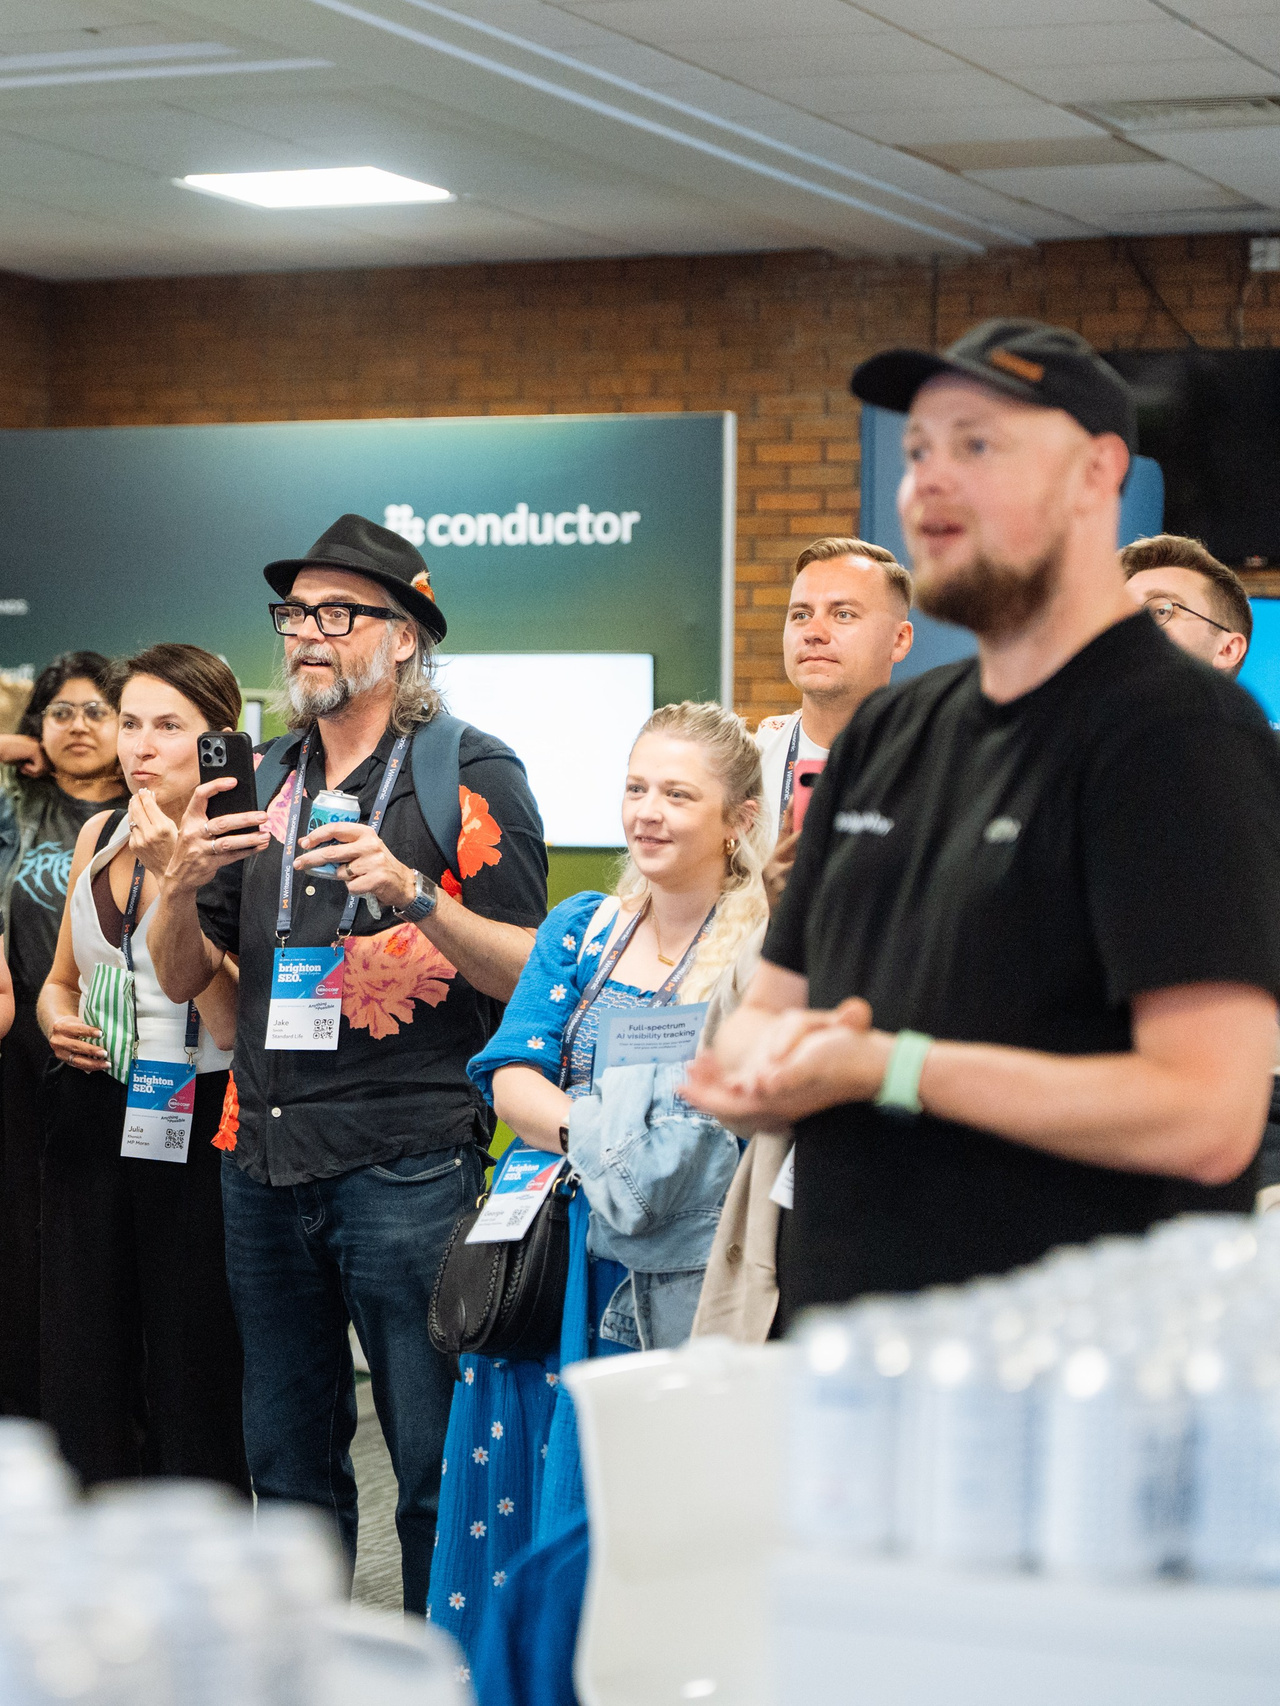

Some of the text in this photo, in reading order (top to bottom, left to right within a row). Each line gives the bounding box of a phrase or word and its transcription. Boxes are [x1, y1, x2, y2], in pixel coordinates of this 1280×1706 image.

[426, 502, 641, 548] conductor
[295, 763, 305, 794] Writesonic
[380, 768, 396, 800] Writesonic
[784, 770, 793, 801] Writesonic
[288, 814, 298, 846] Writesonic
[282, 865, 292, 899] Writesonic
[128, 886, 138, 915] Writesonic
[278, 963, 322, 974] brighton
[278, 974, 302, 982] SEO.
[590, 960, 614, 991] Writesonic
[672, 952, 696, 983] Writesonic
[565, 1009, 584, 1044] Writesonic
[627, 1032, 662, 1040] visibility
[663, 1030, 696, 1038] tracking
[628, 1022, 686, 1032] Full-spectrum
[132, 1084, 156, 1094] SEO.
[133, 1074, 174, 1086] brighton
